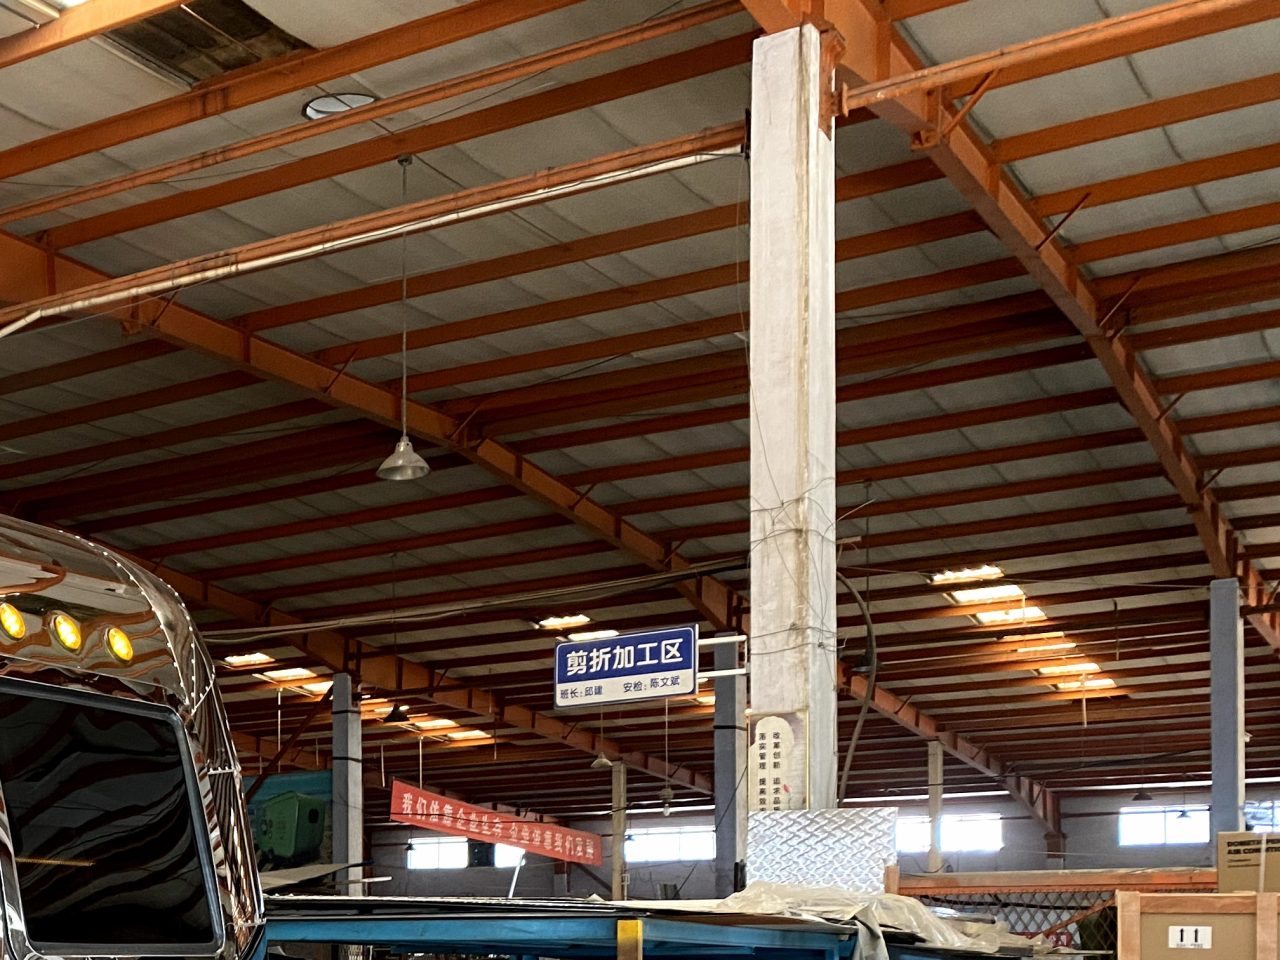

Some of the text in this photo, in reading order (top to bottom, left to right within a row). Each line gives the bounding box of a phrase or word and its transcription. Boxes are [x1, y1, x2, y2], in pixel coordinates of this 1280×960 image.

[566, 638, 684, 676] 剪折加工区
